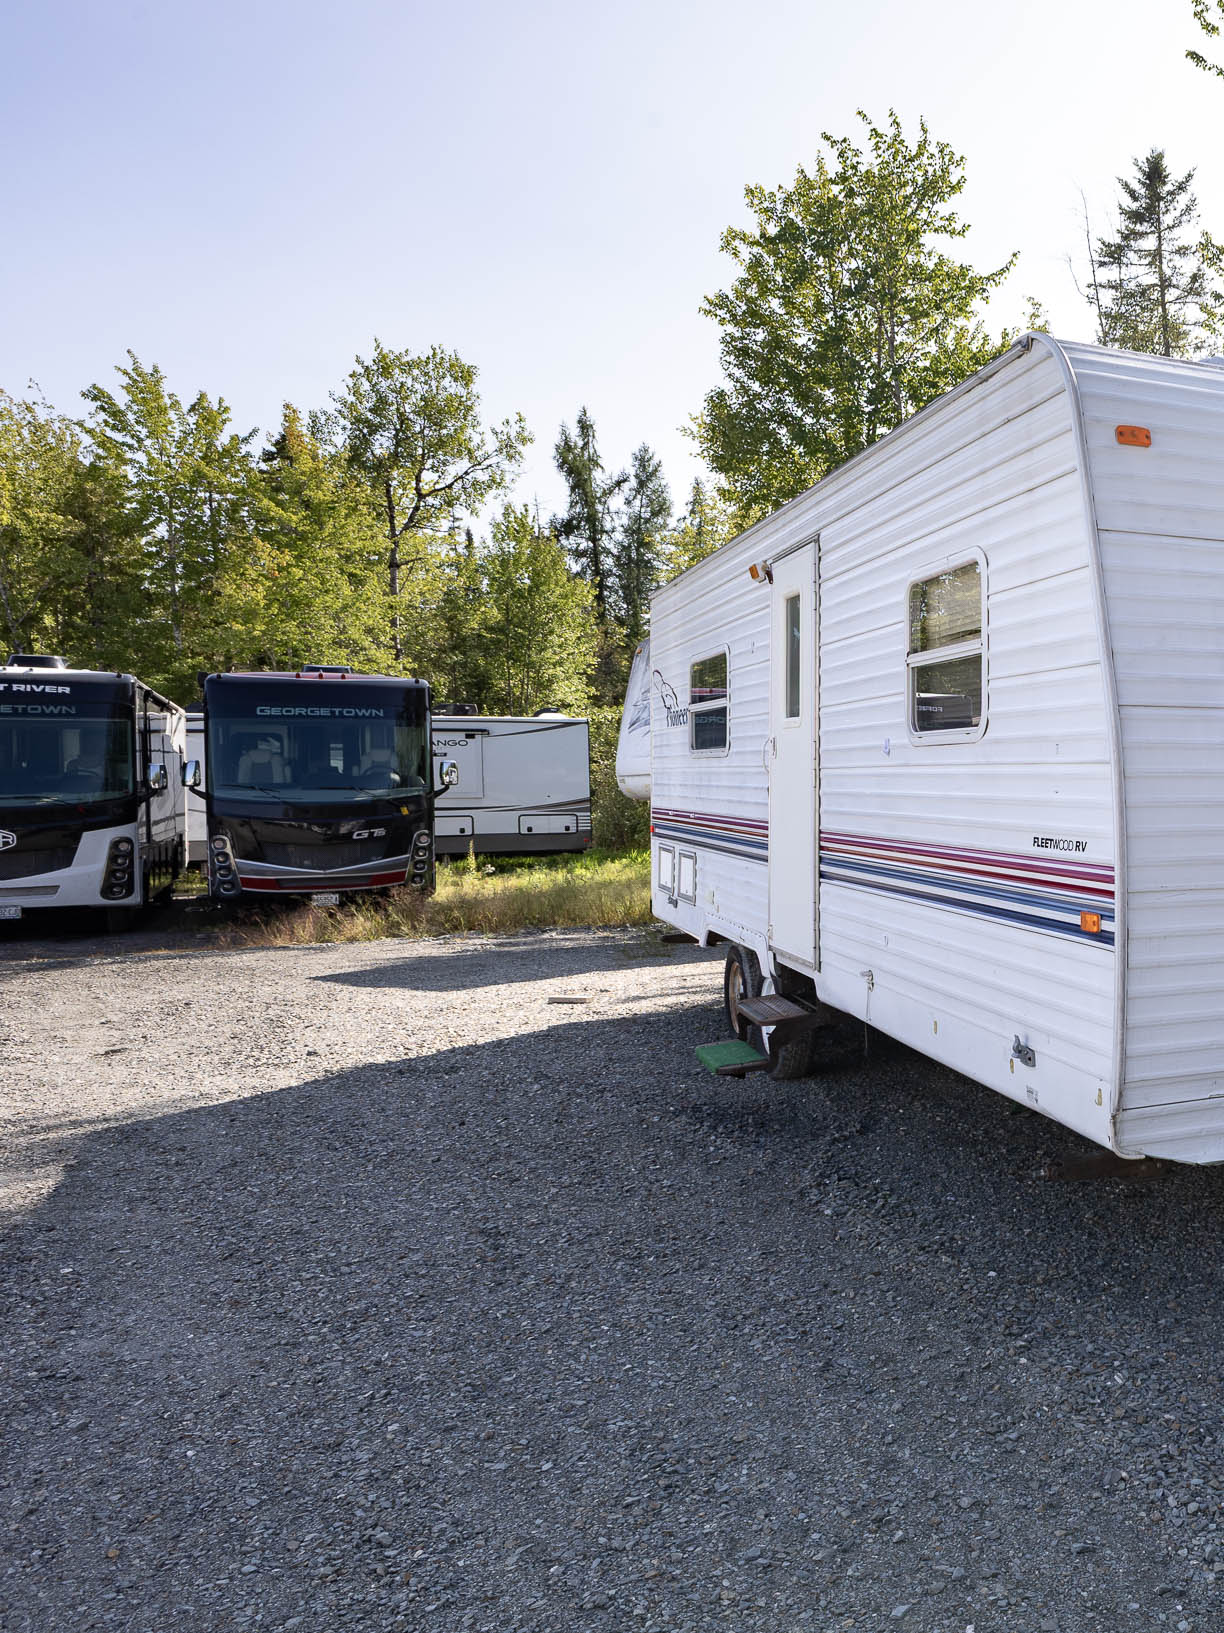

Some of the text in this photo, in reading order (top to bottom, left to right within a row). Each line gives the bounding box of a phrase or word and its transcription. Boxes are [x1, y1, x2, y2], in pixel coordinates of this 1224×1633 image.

[12, 684, 71, 694] RIVER
[0, 704, 77, 714] ETOWN
[256, 706, 384, 717] GEORGETOWN
[1032, 836, 1088, 853] FLEETWOOD RV
